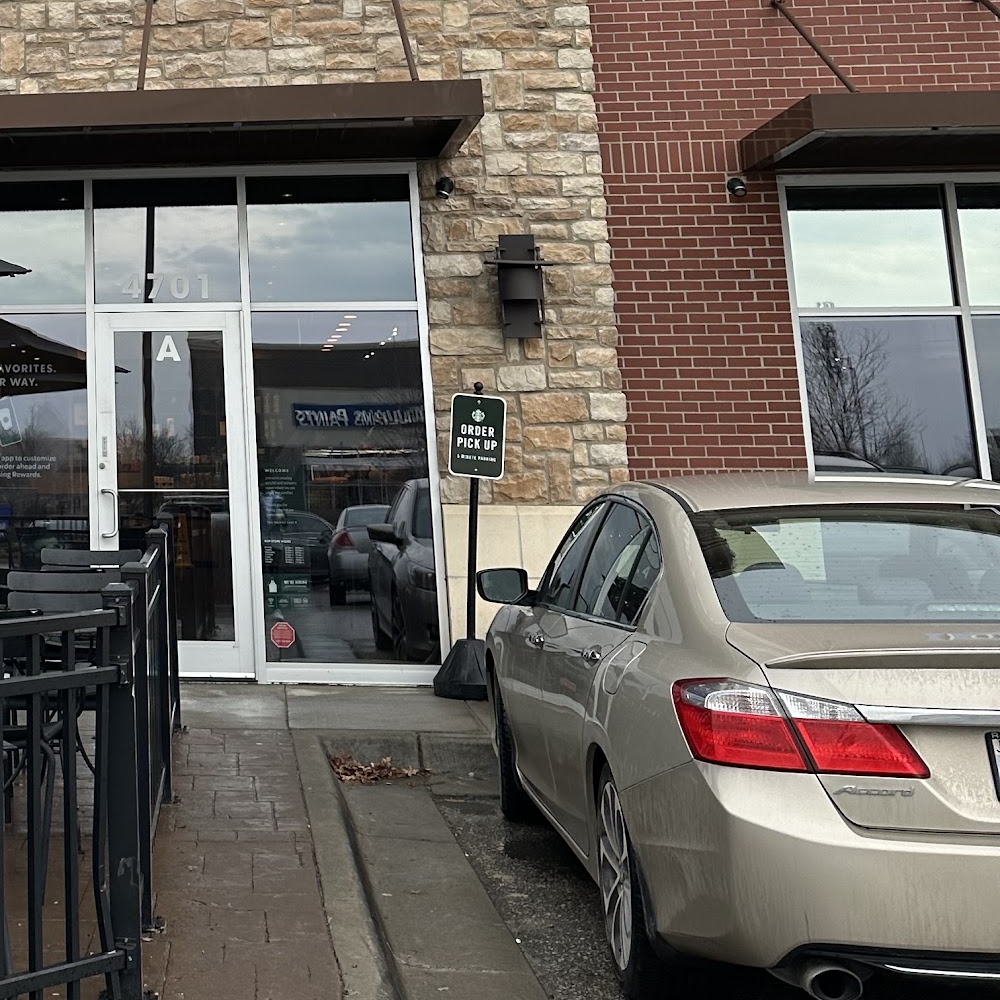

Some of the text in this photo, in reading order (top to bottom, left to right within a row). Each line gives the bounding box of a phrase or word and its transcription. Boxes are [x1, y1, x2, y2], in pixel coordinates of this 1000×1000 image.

[121, 272, 209, 300] 4701
[155, 334, 182, 362] A
[10, 377, 39, 387] WAY.
[460, 424, 495, 437] ORDER
[456, 437, 498, 451] PICK UP
[833, 785, 915, 797] Accord
